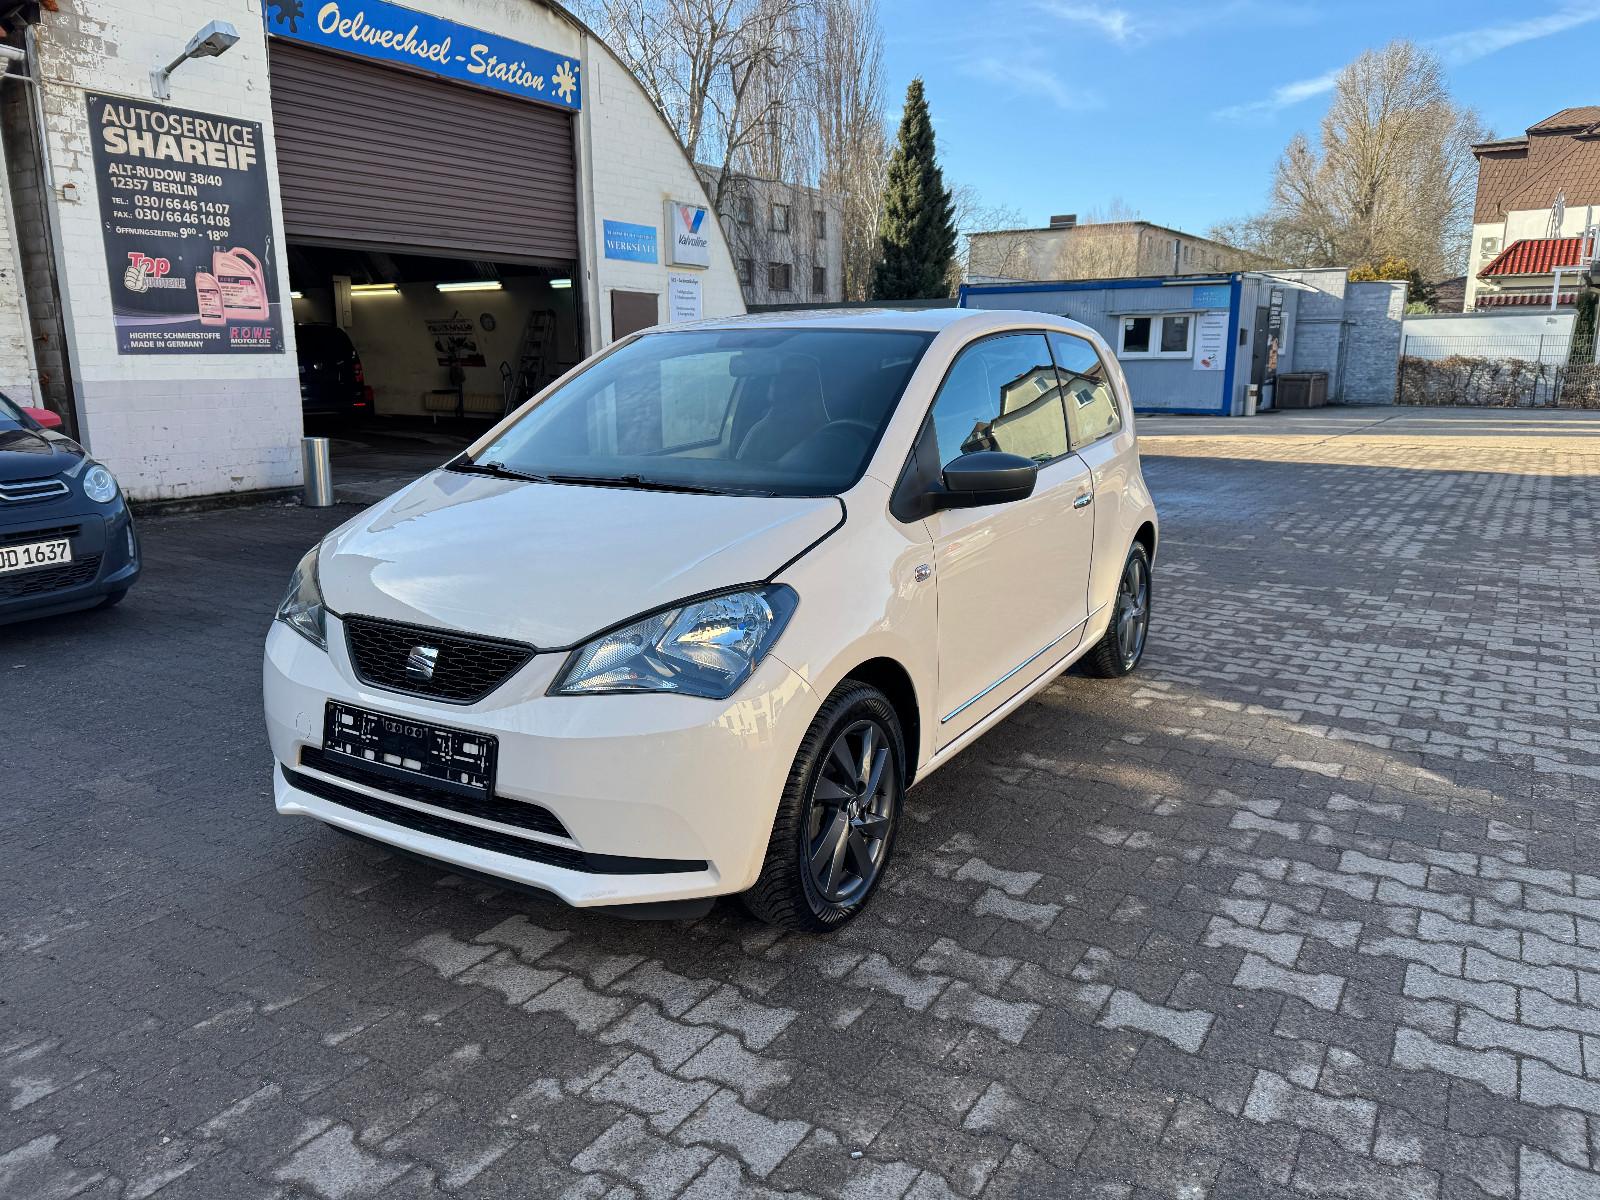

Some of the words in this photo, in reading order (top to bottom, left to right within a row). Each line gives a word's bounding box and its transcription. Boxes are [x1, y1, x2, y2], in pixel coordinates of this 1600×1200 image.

[317, 1, 452, 65] Oelwechsel
[102, 103, 255, 147] AUTOSERVICE
[102, 126, 257, 171] SHAREIF
[108, 162, 186, 182] ALT-RUDOW
[189, 172, 223, 187] 38/40
[111, 176, 148, 191] 12357
[152, 180, 198, 197] BERLIN
[678, 234, 708, 248] Valvoline
[128, 251, 171, 278] Top
[129, 332, 162, 340] HIGHTEC
[163, 332, 221, 340] SCHMIERSTOFFE
[130, 340, 155, 348] MADE
[156, 340, 166, 348] IN
[167, 340, 204, 348] GERMANY
[229, 327, 272, 339] ROWE
[22, 542, 67, 565] 1637
